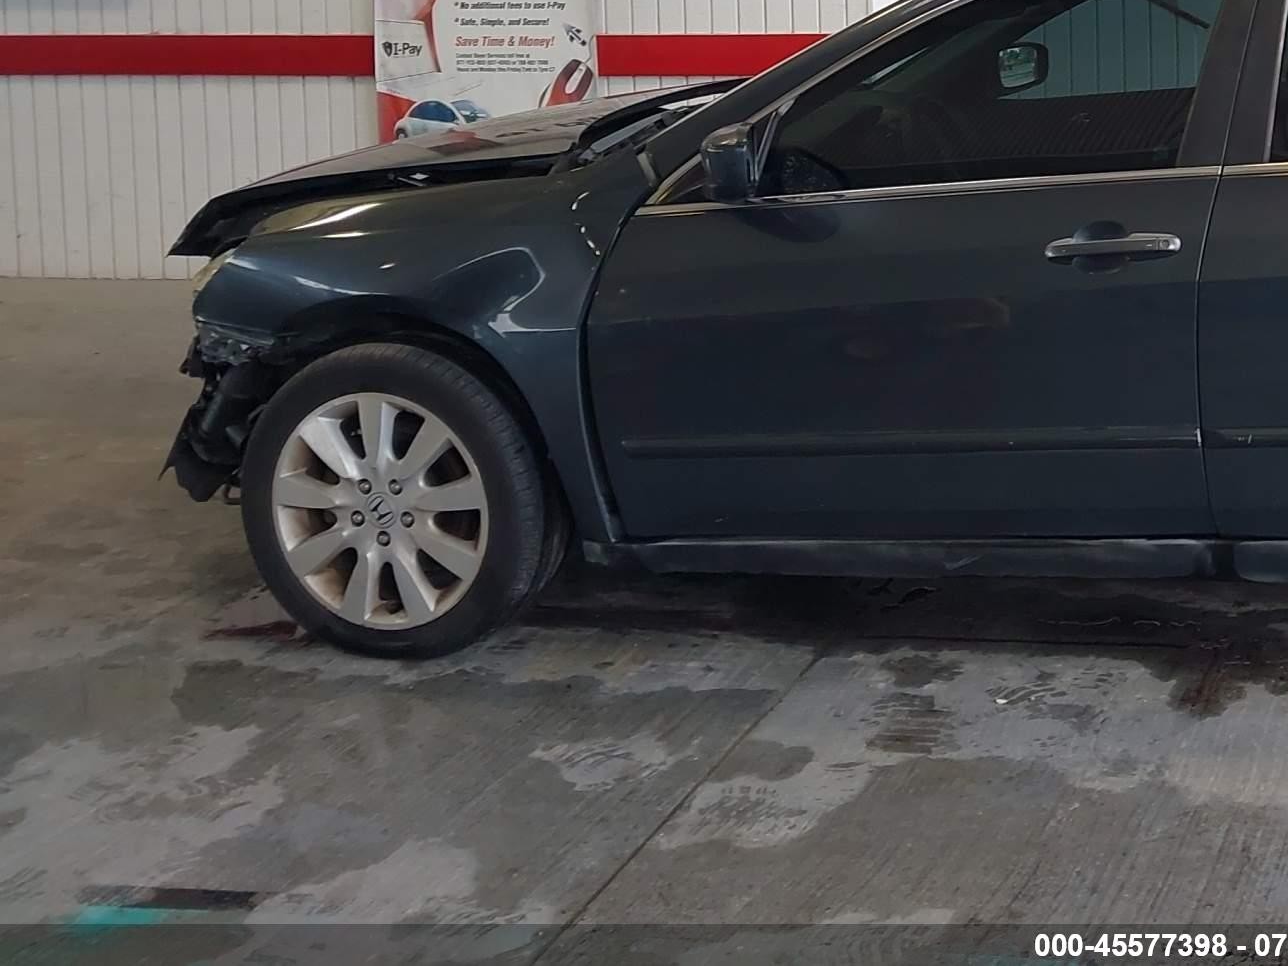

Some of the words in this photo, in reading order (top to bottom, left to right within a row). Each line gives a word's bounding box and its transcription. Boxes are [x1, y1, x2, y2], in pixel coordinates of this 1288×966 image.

[471, 1, 506, 9] additional
[546, 2, 566, 10] I-Pay
[460, 18, 479, 26] Safe,
[480, 18, 506, 27] Simple,
[522, 18, 550, 26] Secure!
[456, 36, 480, 47] Save
[482, 36, 505, 47] Time
[507, 36, 516, 47] &
[518, 36, 555, 48] Money!
[393, 42, 422, 57] I-Pay
